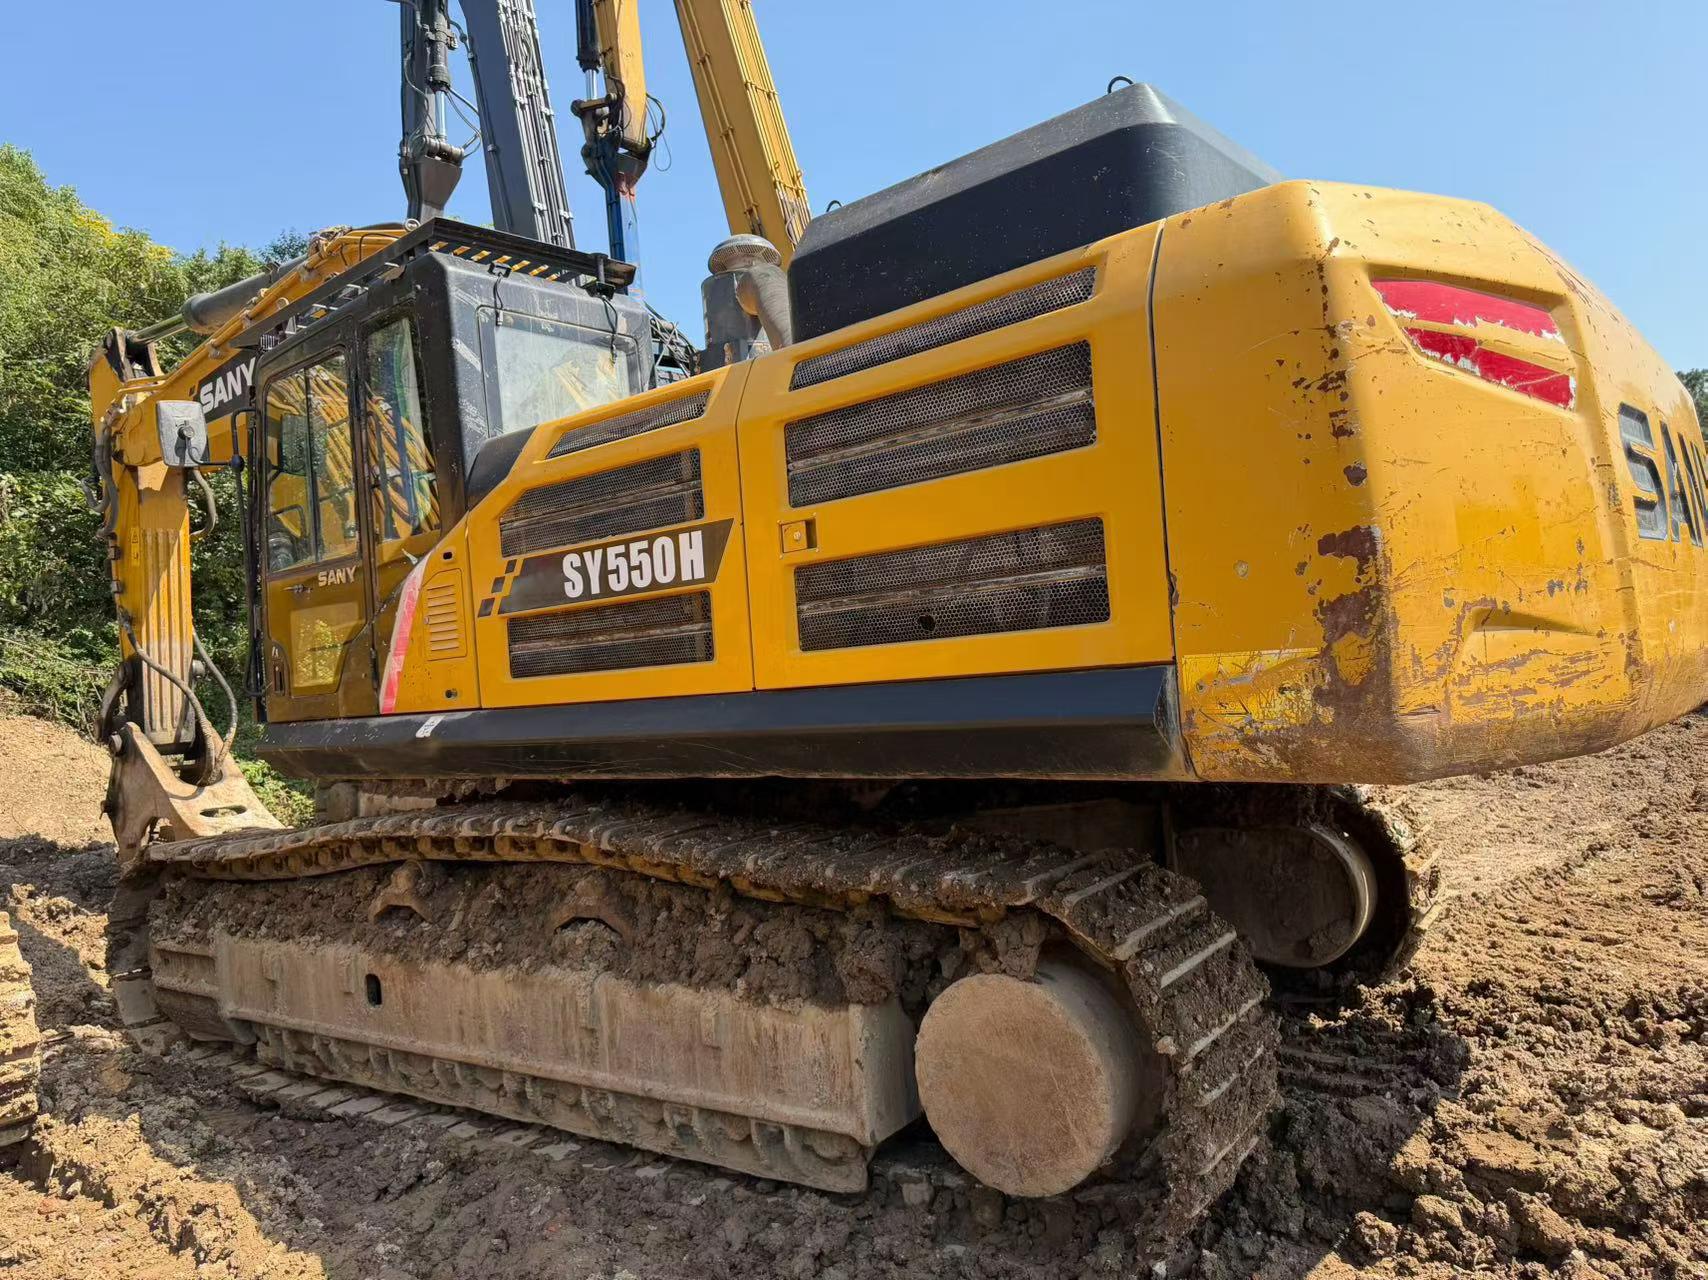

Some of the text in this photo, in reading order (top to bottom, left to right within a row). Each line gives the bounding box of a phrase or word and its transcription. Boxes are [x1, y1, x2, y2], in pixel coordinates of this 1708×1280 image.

[200, 357, 256, 414] SANY
[318, 565, 357, 587] SANY
[562, 530, 705, 598] SY550H
